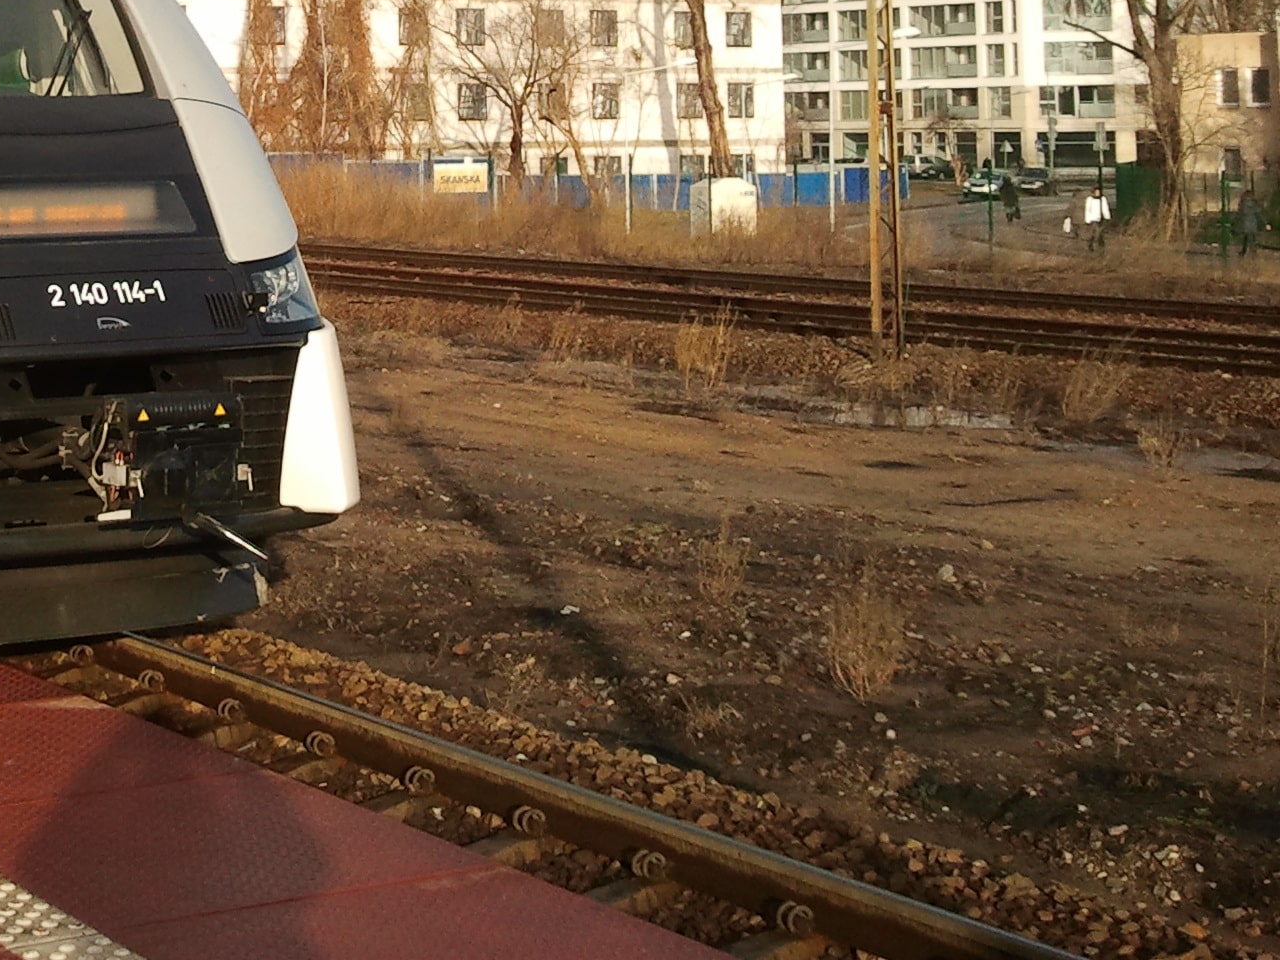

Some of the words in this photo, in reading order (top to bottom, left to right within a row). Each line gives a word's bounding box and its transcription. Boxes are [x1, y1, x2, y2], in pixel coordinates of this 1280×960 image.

[440, 175, 481, 184] SKANSKA
[47, 284, 66, 307] 2
[69, 282, 109, 305] 140
[112, 279, 167, 303] 114-1
